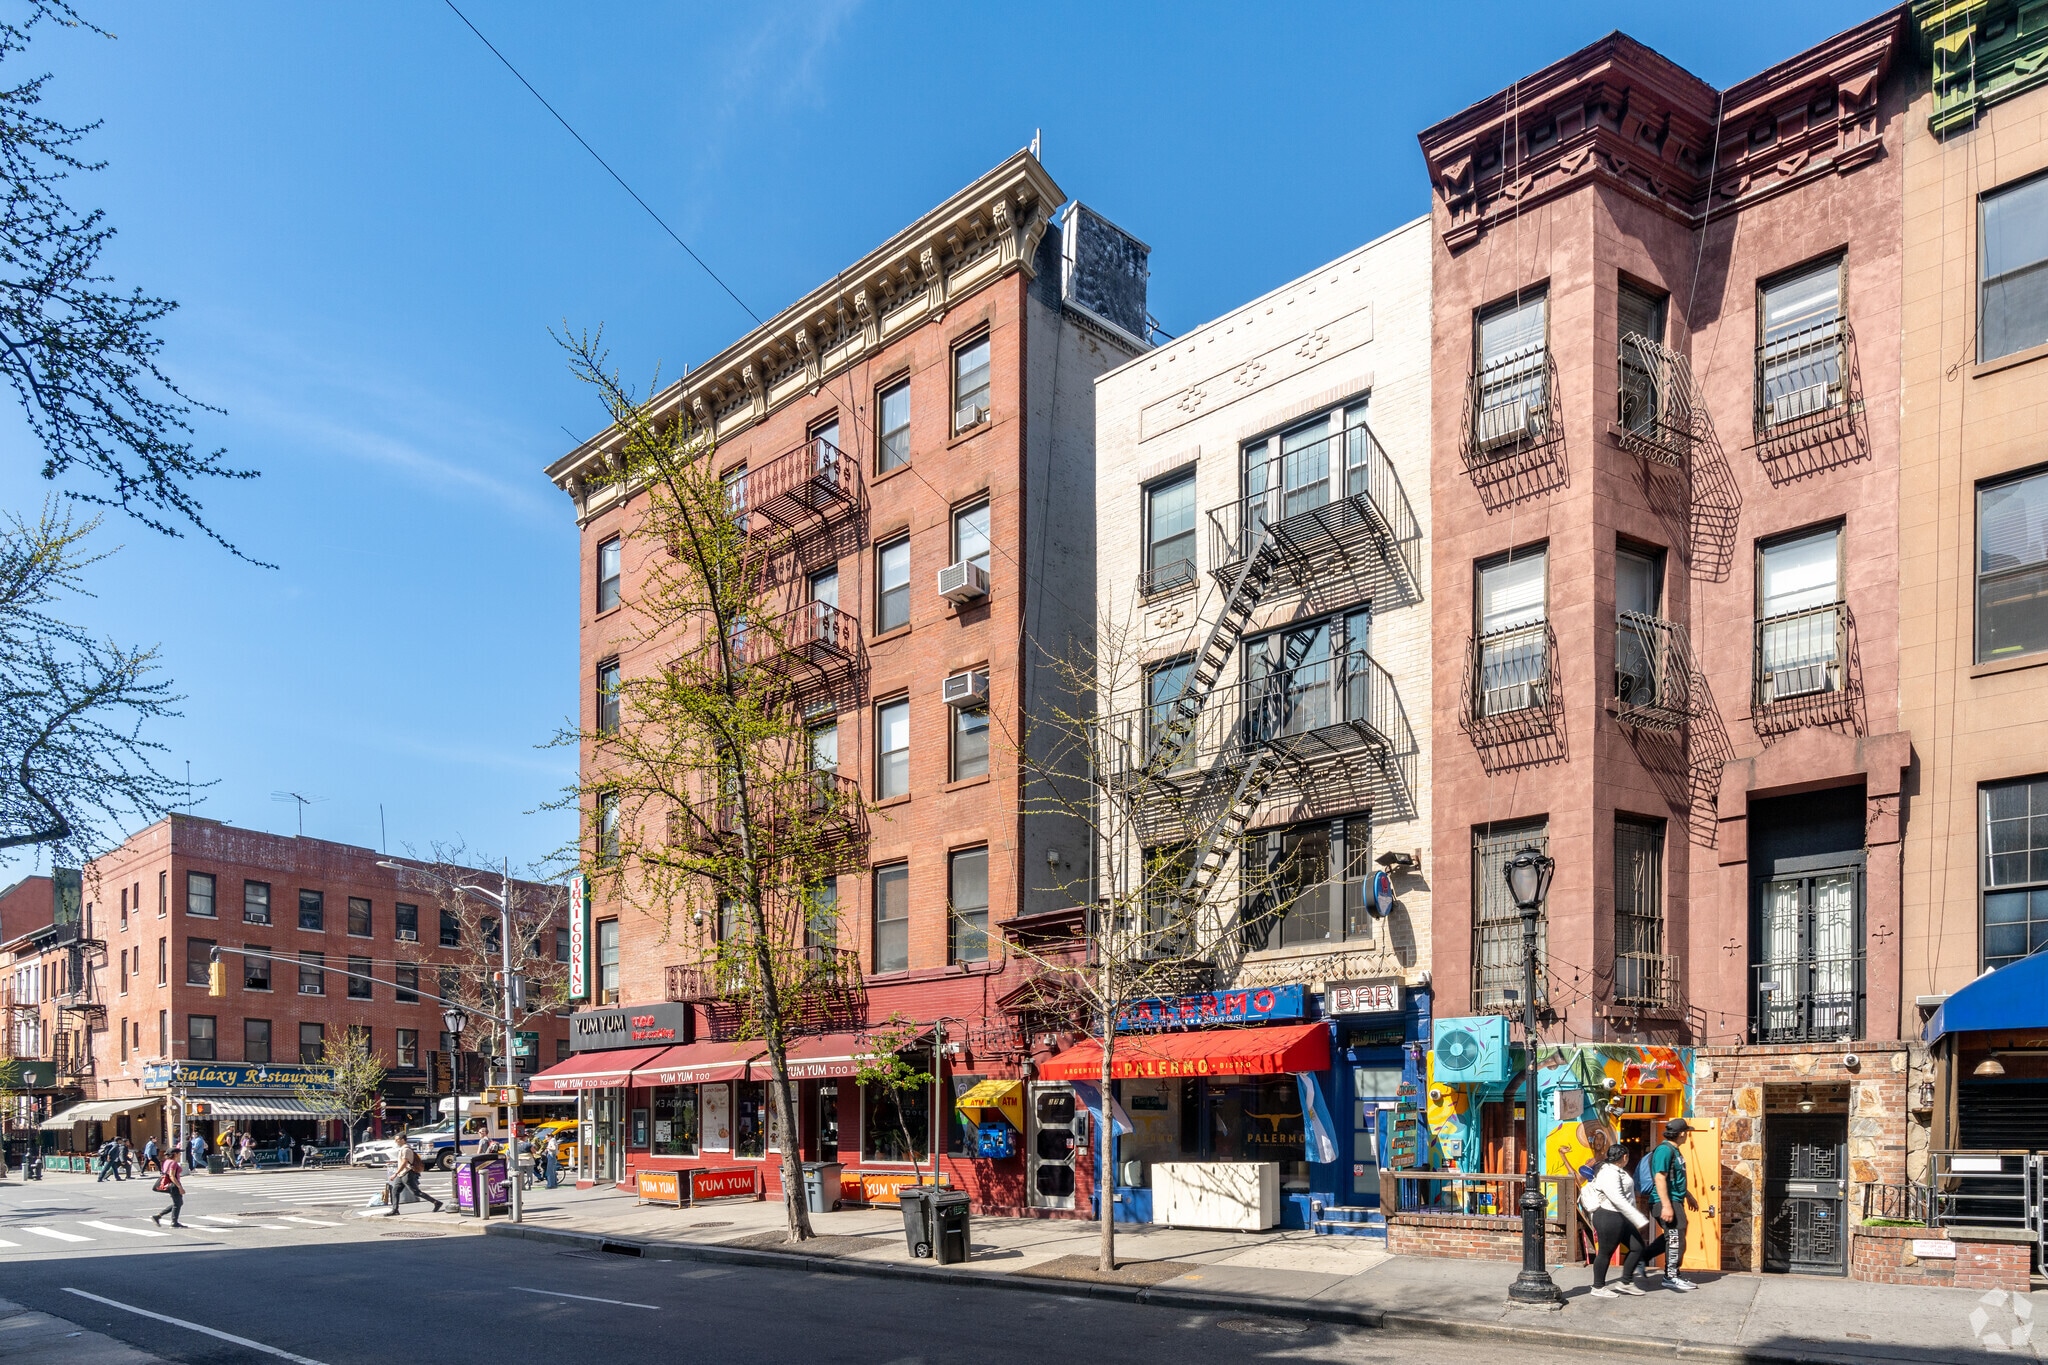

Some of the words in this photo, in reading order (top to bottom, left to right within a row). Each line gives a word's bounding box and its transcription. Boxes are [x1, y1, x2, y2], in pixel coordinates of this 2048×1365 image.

[572, 878, 581, 919] THAI
[572, 922, 582, 994] COOKING
[1335, 984, 1393, 1009] BAR
[1117, 989, 1276, 1024] ALERMO
[575, 1018, 599, 1034] YUM
[600, 1015, 625, 1031] YUM
[631, 1014, 655, 1027] TOO
[1204, 1014, 1243, 1025] EAKOUSE
[787, 1066, 805, 1077] YUM
[807, 1064, 827, 1076] YUM
[830, 1066, 848, 1074] TOO
[1064, 1066, 1115, 1075] ARGENTINN
[1124, 1059, 1208, 1076] PALERMO
[1219, 1061, 1251, 1069] BISTRO
[177, 1067, 237, 1086] Galaxy
[660, 1073, 676, 1083] YUM
[677, 1072, 693, 1081] YUM
[553, 1080, 568, 1089] YUM
[569, 1079, 583, 1088] YUM
[1002, 1097, 1018, 1106] ATM
[1247, 1133, 1305, 1143] PALERMO
[641, 1181, 658, 1192] YUM
[659, 1182, 676, 1193] YUM
[698, 1179, 724, 1192] YUM
[726, 1177, 752, 1189] YUM
[866, 1183, 888, 1195] YUM
